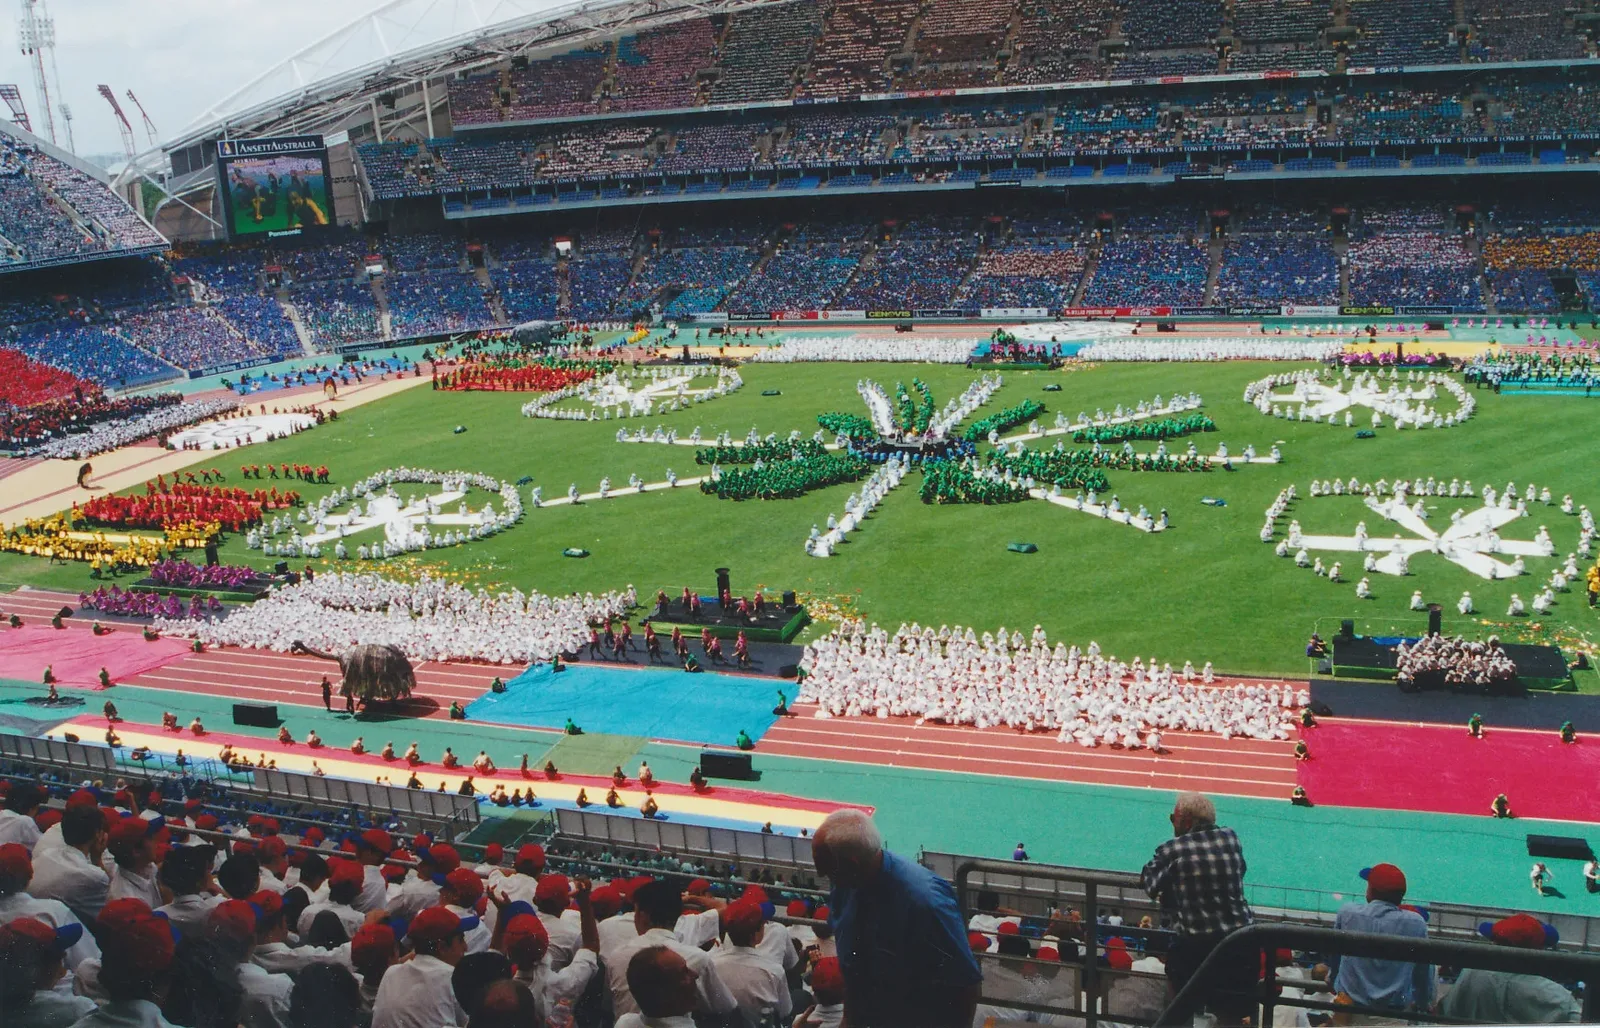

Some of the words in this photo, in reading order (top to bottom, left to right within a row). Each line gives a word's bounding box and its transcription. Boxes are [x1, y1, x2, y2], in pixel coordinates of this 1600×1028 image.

[240, 144, 270, 153] ANSETT
[269, 141, 316, 150] AUSTRALIA
[268, 229, 301, 237] Panasonic
